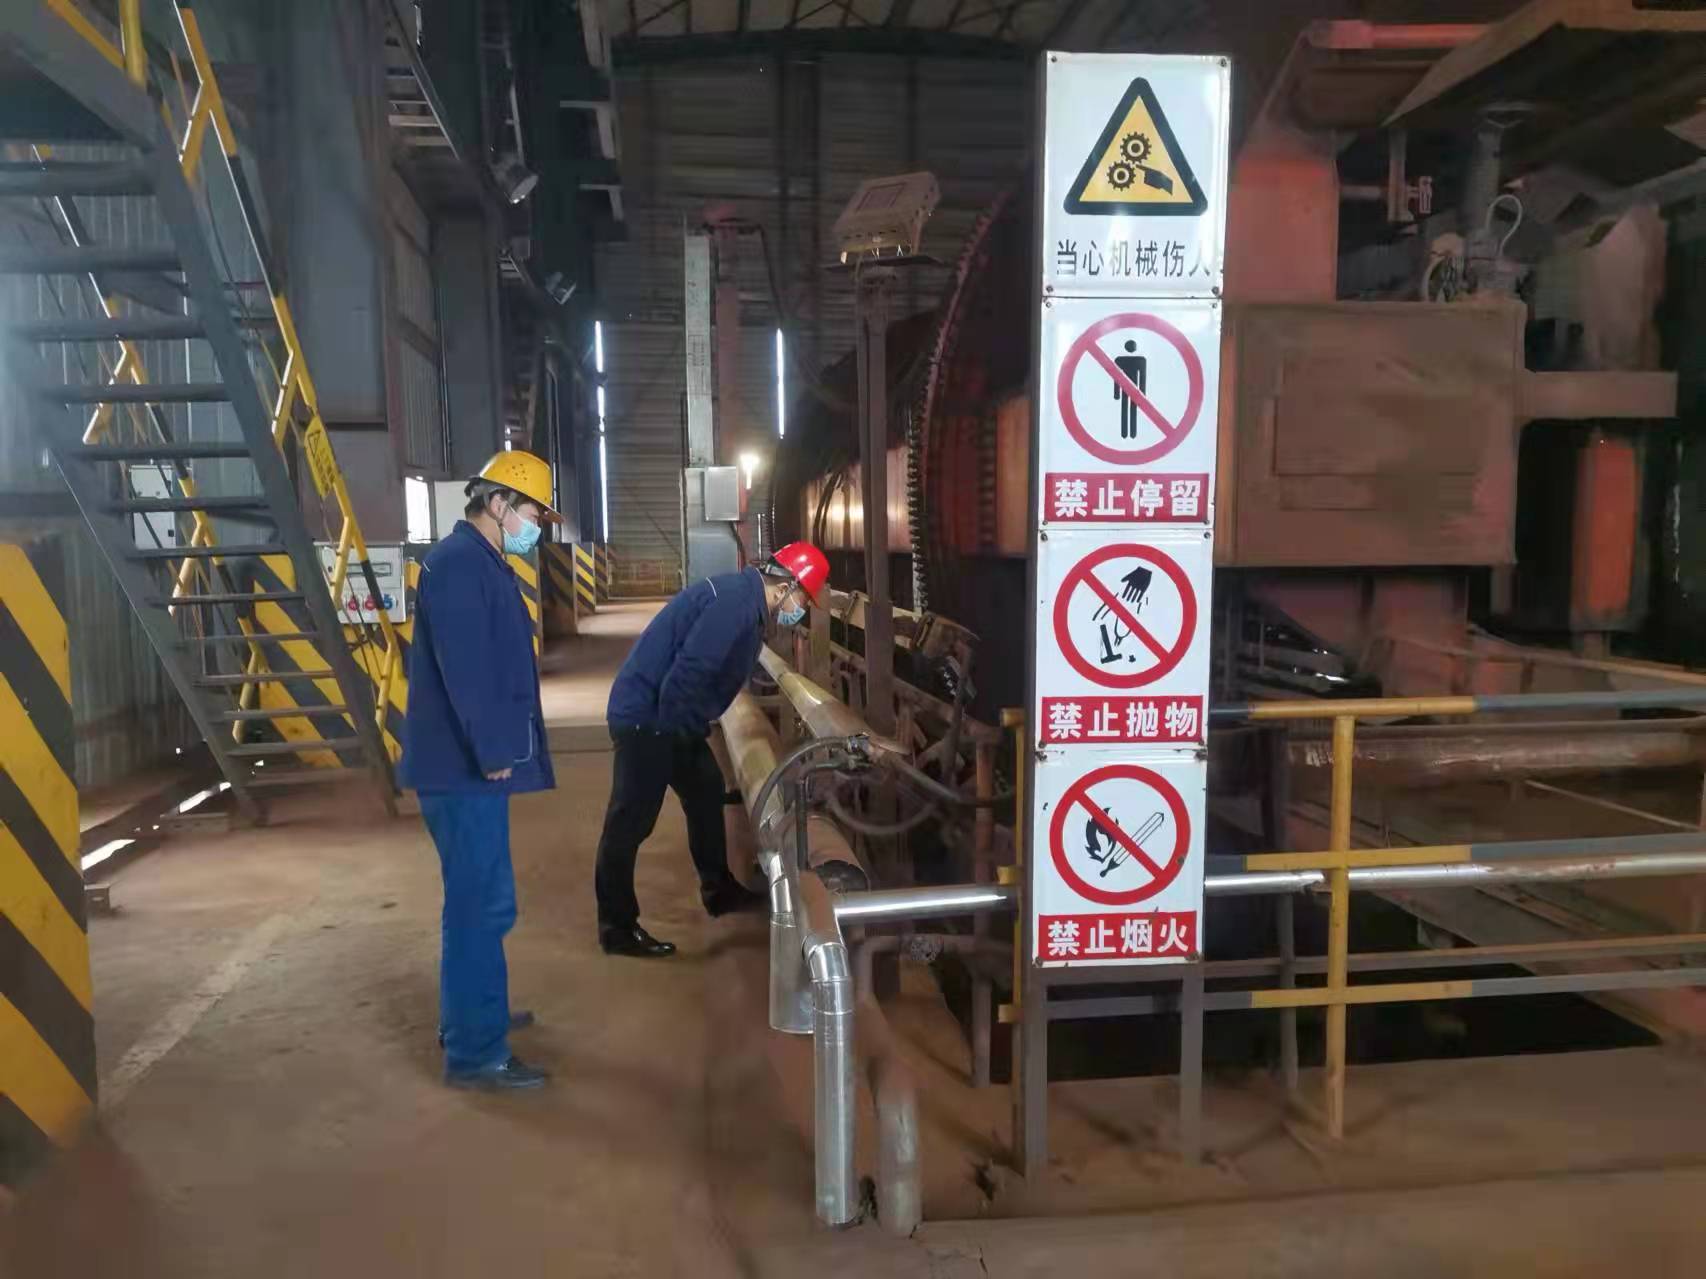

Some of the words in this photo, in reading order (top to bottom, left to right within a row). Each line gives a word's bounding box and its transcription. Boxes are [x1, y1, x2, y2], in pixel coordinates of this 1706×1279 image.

[1056, 239, 1210, 277] 当心机械伤人
[1054, 479, 1201, 517] 禁止停留
[1048, 701, 1198, 739] 禁止抛物
[1047, 918, 1189, 956] 禁止烟火
